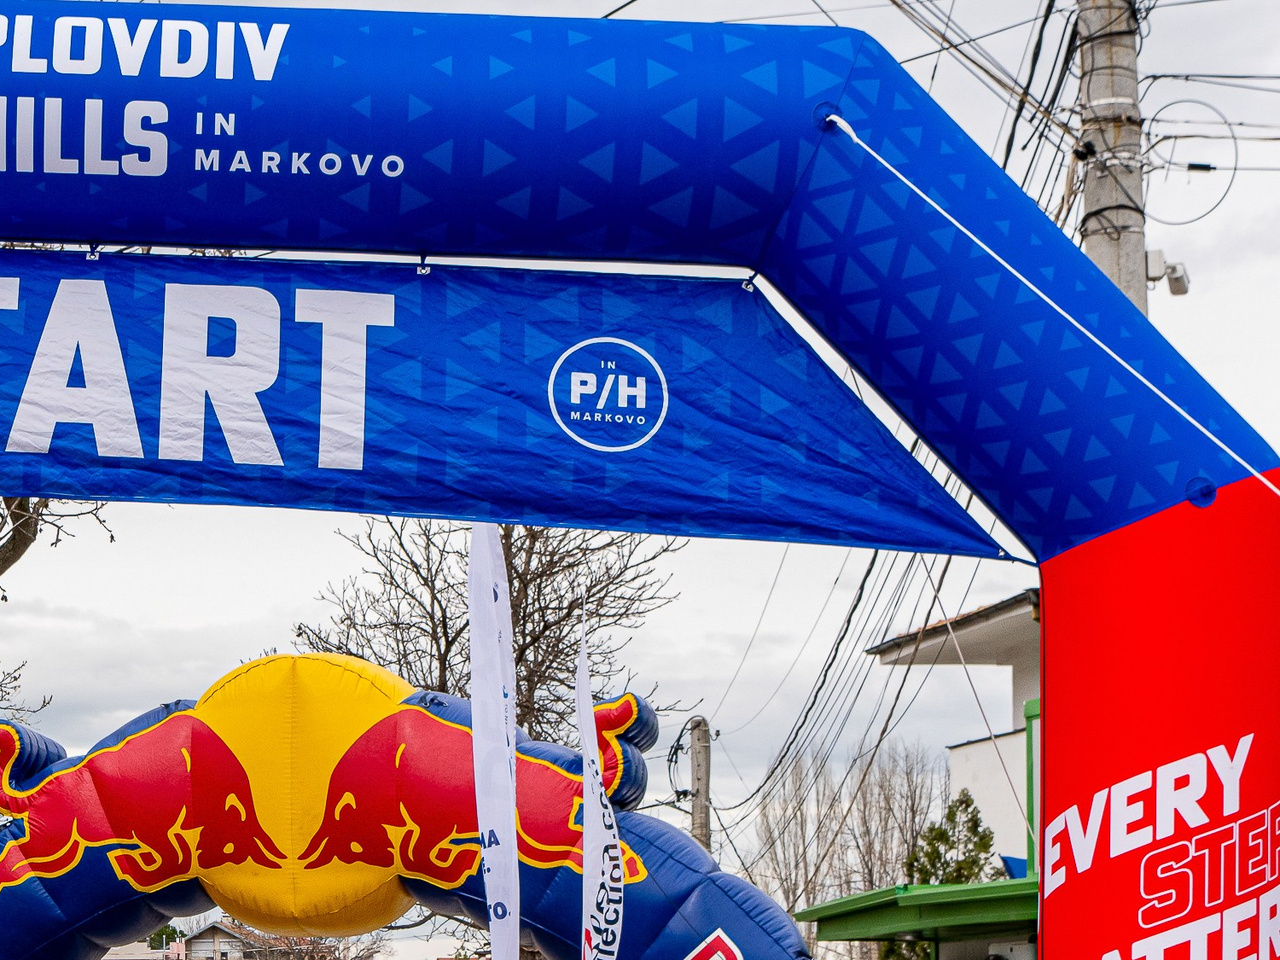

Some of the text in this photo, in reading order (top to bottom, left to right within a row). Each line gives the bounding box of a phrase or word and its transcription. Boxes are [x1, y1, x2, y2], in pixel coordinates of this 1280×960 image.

[195, 111, 236, 136] IN
[194, 148, 405, 178] MARKOVO
[601, 360, 616, 369] IN
[570, 371, 646, 409] P/H
[570, 411, 646, 425] MARKOVO
[1044, 733, 1254, 899] EVERY
